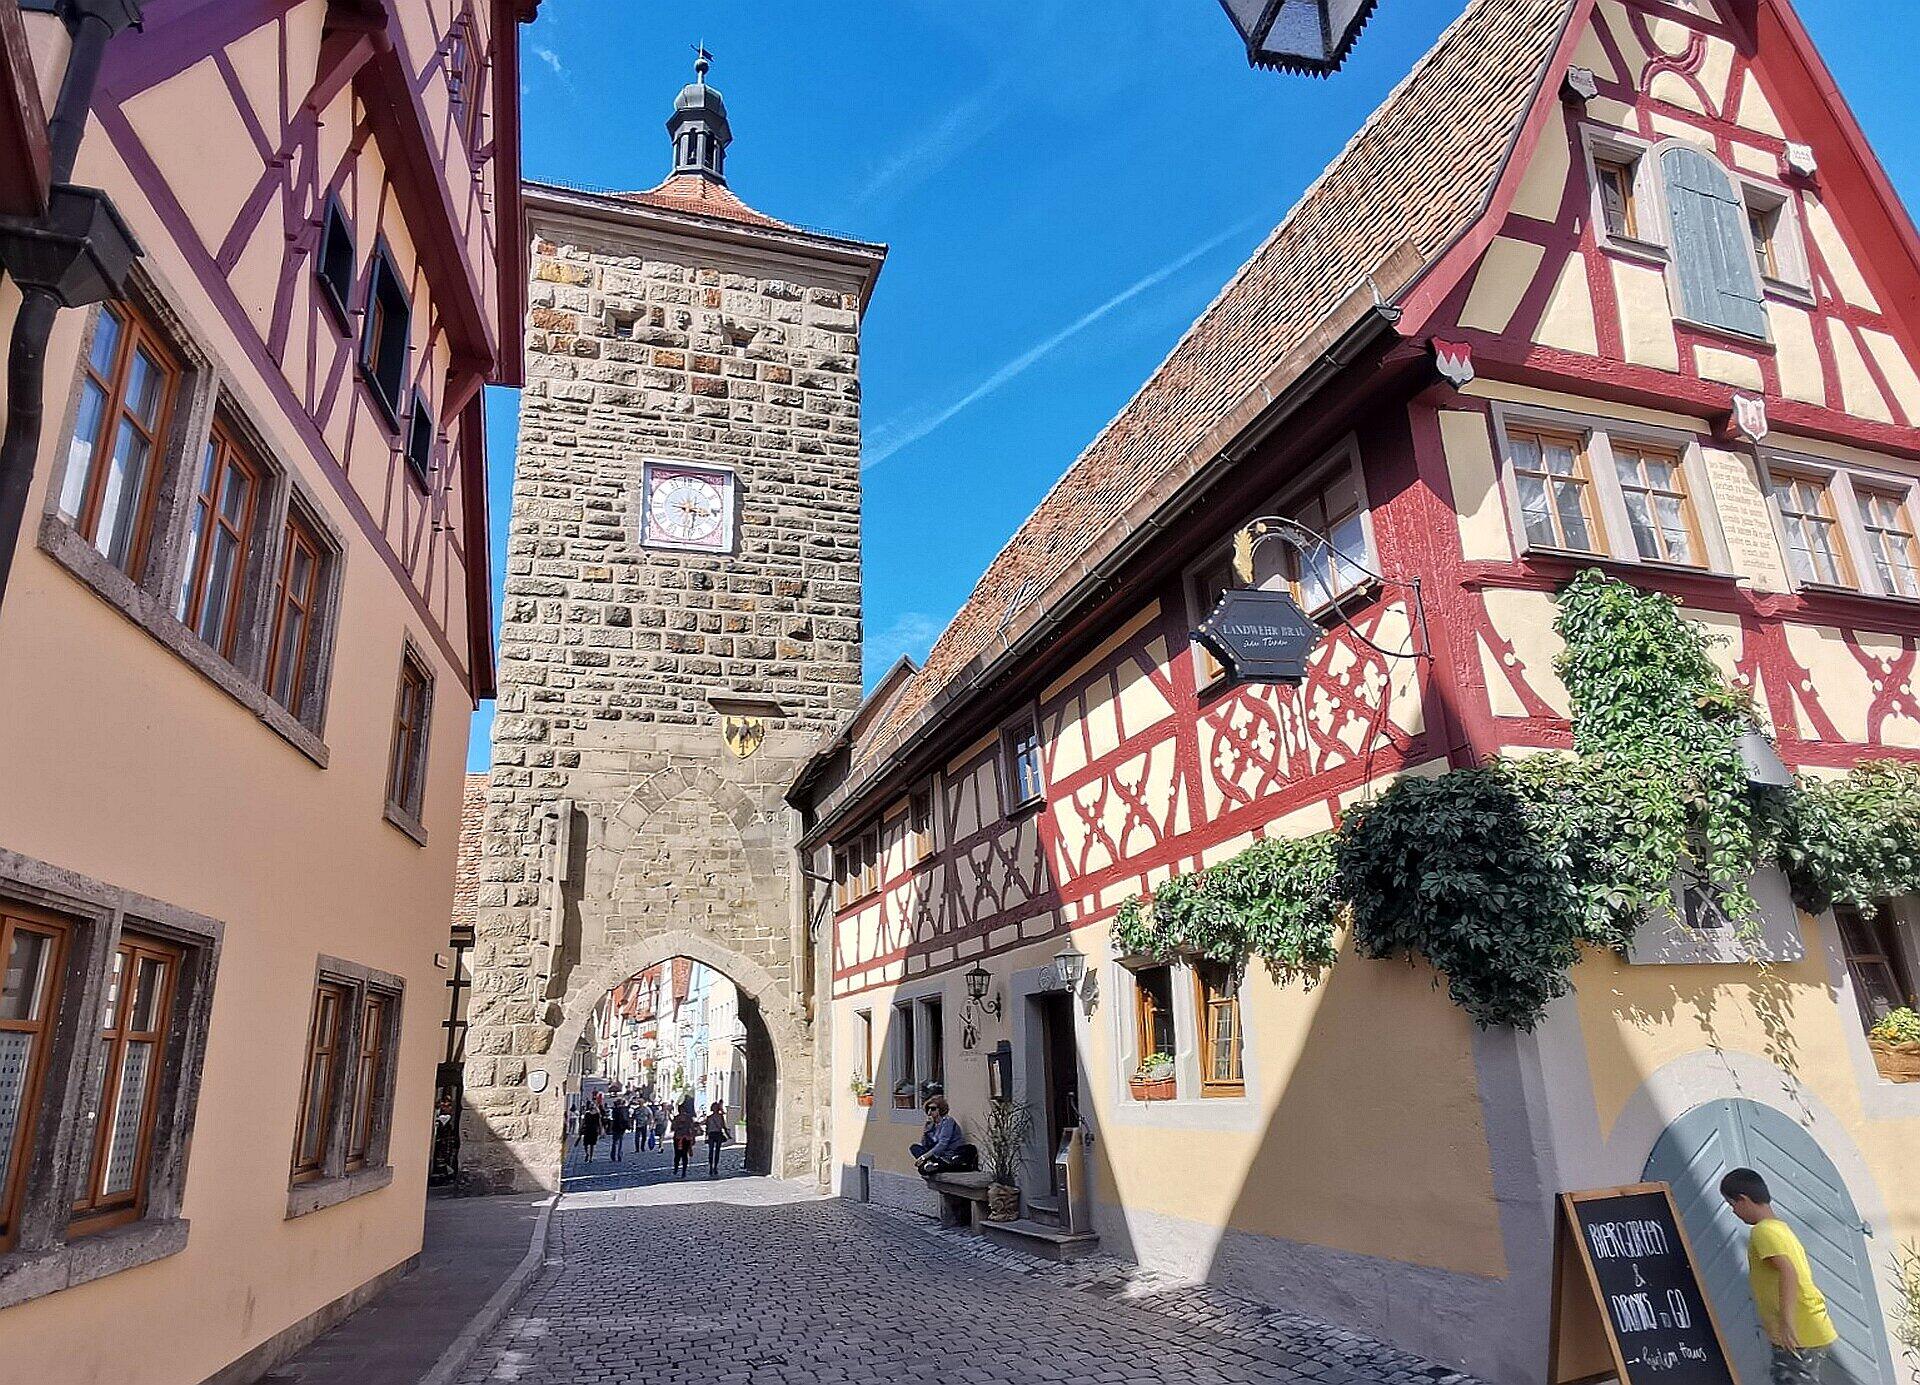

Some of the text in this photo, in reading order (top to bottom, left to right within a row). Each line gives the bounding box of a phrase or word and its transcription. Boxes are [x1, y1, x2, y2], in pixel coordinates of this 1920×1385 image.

[1222, 624, 1279, 636] LANDWEHR
[1611, 1292, 1658, 1333] DRINKS
[1667, 1289, 1692, 1329] GO
